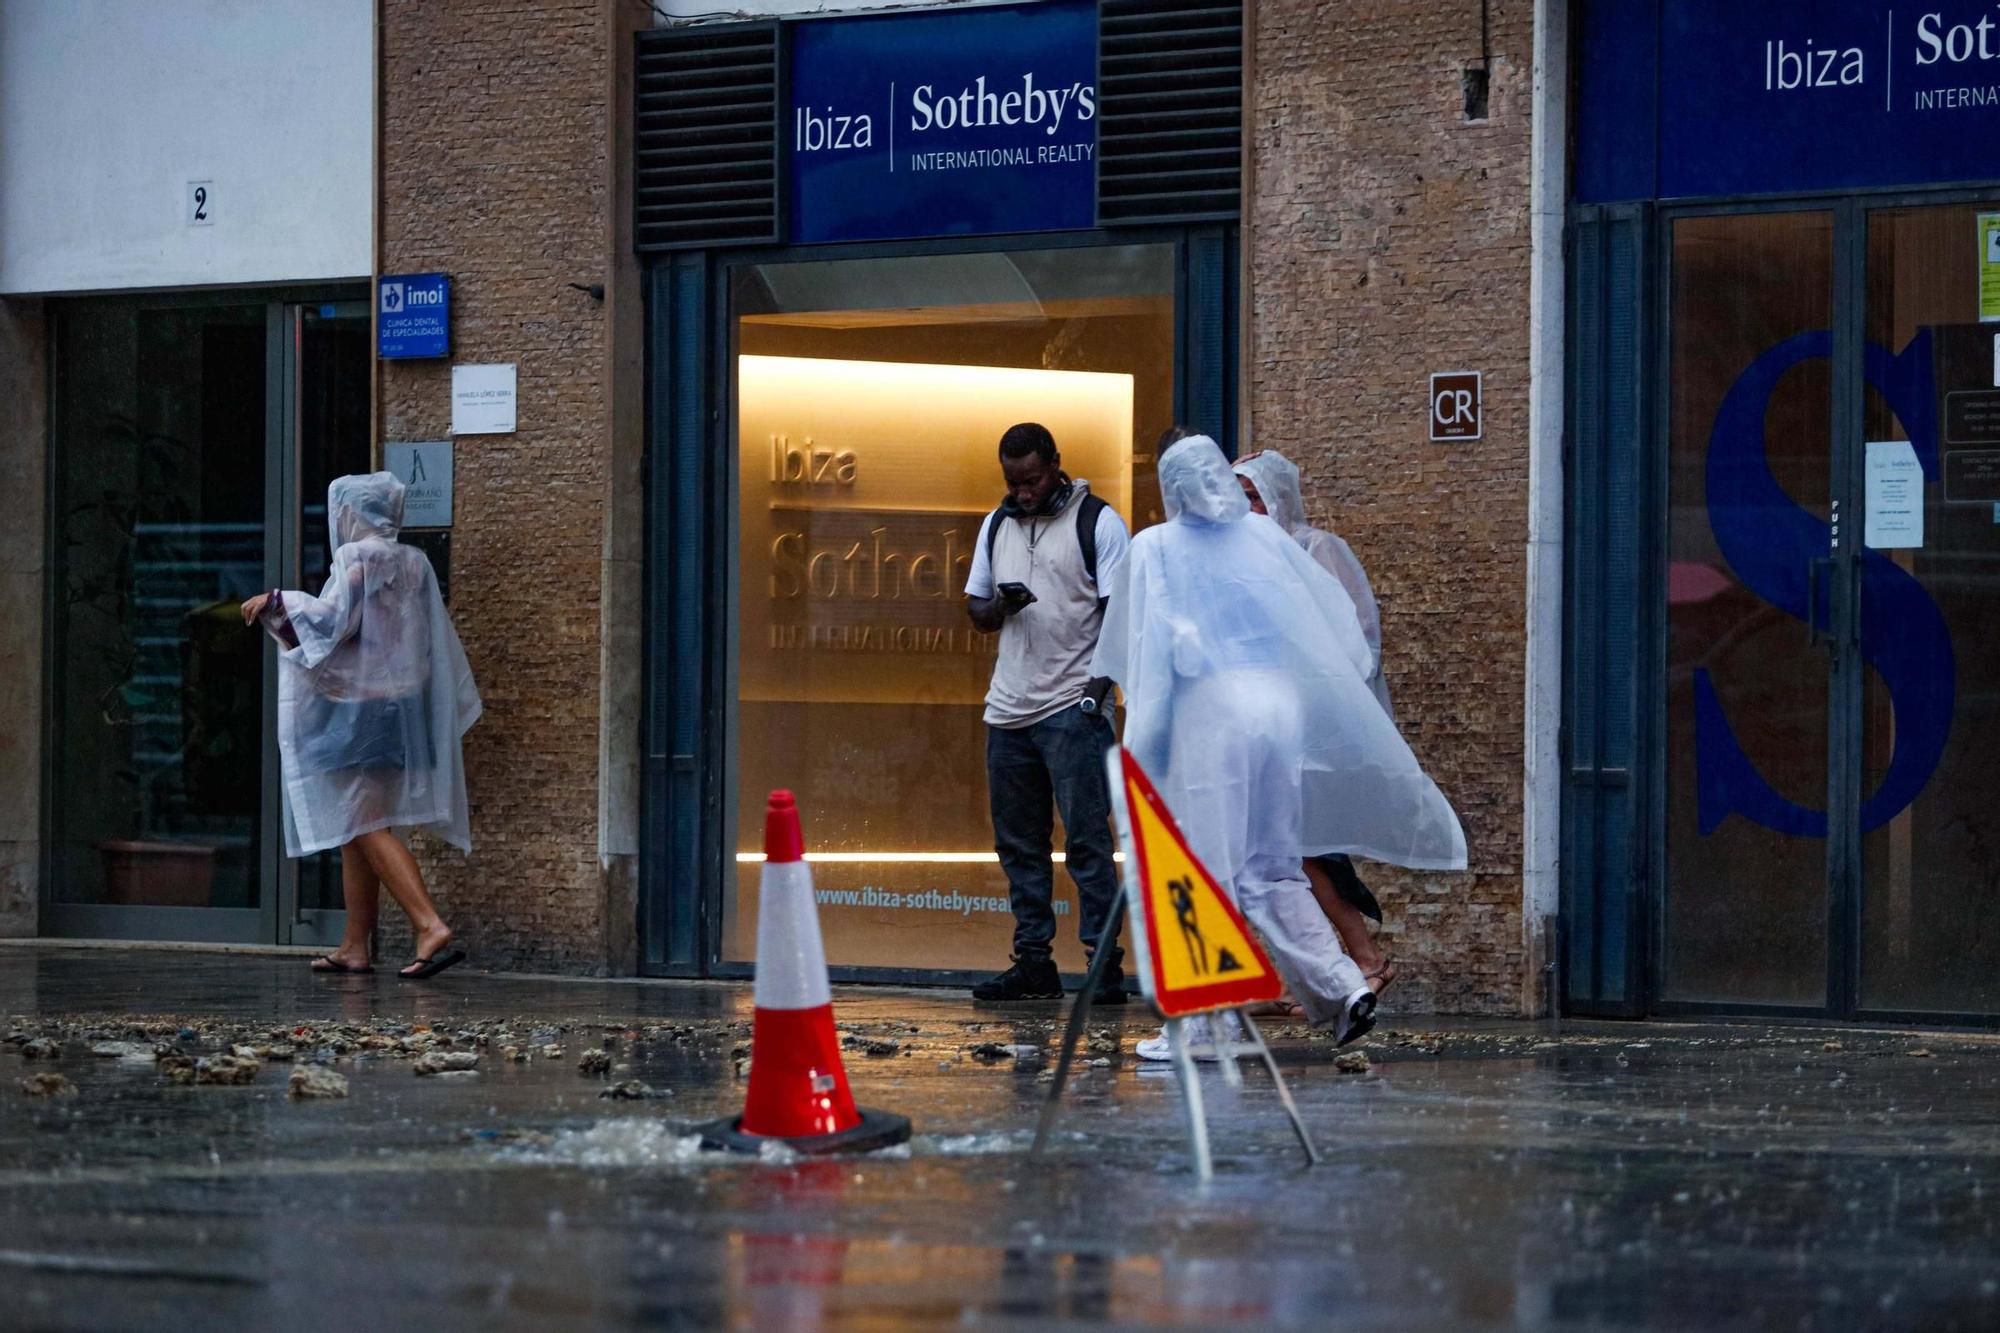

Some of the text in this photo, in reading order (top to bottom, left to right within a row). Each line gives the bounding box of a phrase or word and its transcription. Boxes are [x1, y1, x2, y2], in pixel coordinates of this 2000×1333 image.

[1766, 3, 2000, 90] Ibiza Sot
[796, 72, 1096, 151] Ibiza Sotheby's
[1915, 85, 2000, 110] INTERNA
[911, 143, 1095, 172] INTERNATIONAL REALTY
[194, 186, 207, 221] 2
[407, 284, 444, 305] imoi
[1435, 389, 1475, 425] CR
[769, 435, 856, 483] Ibiza
[1831, 500, 1839, 548] PUSH
[770, 527, 973, 599] Sotheb
